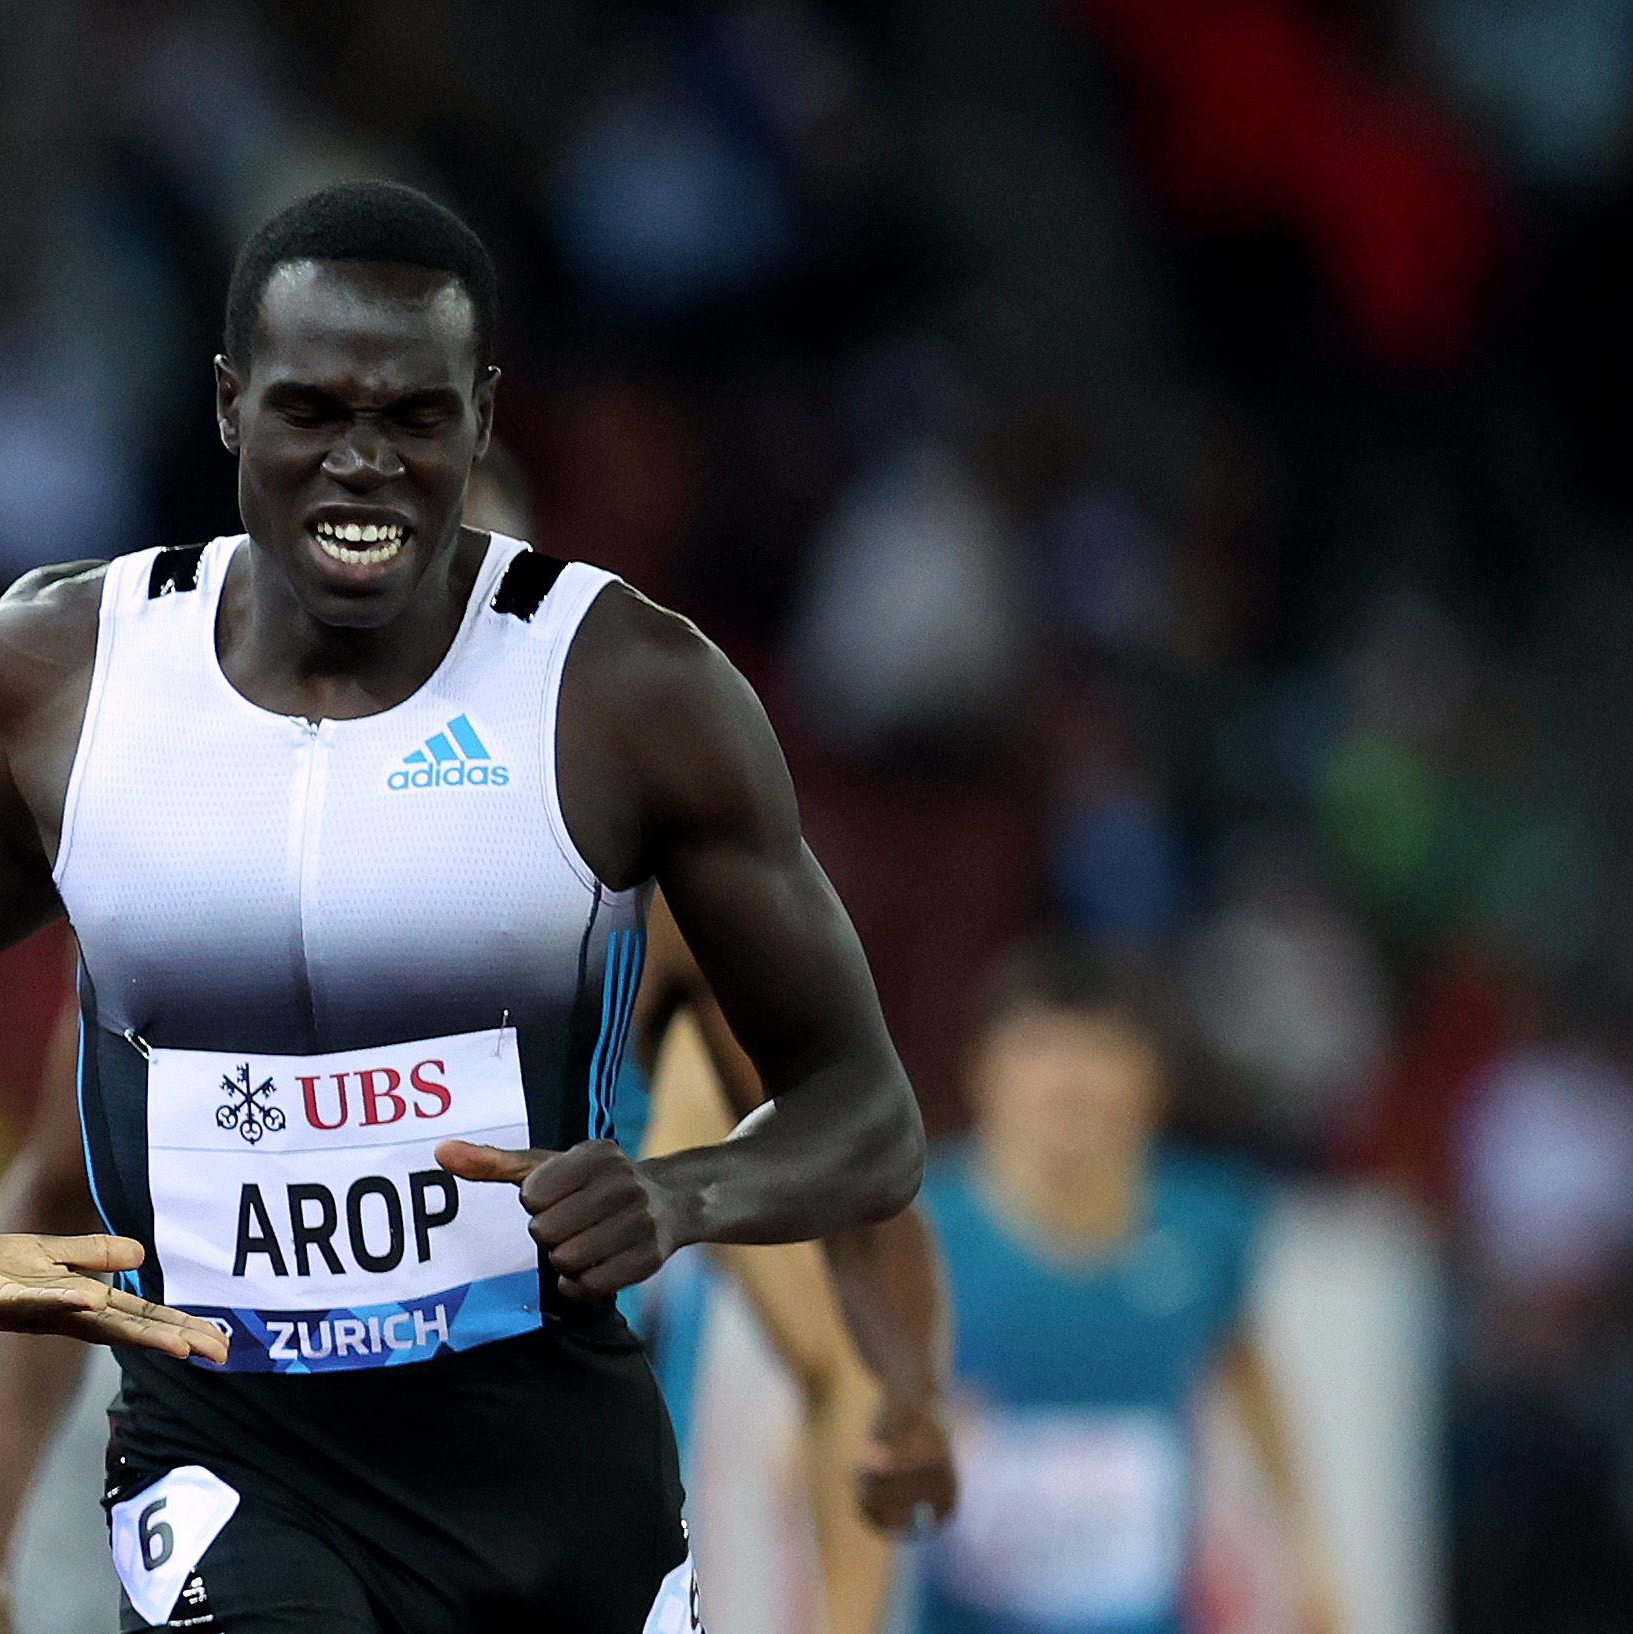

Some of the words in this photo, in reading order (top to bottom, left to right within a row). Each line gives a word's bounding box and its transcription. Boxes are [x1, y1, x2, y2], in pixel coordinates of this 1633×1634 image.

[387, 760, 510, 791] adidas
[295, 1061, 452, 1131] UBS
[232, 1170, 461, 1278] AROP
[266, 1304, 449, 1361] ZURICH
[138, 1496, 174, 1572] 6
